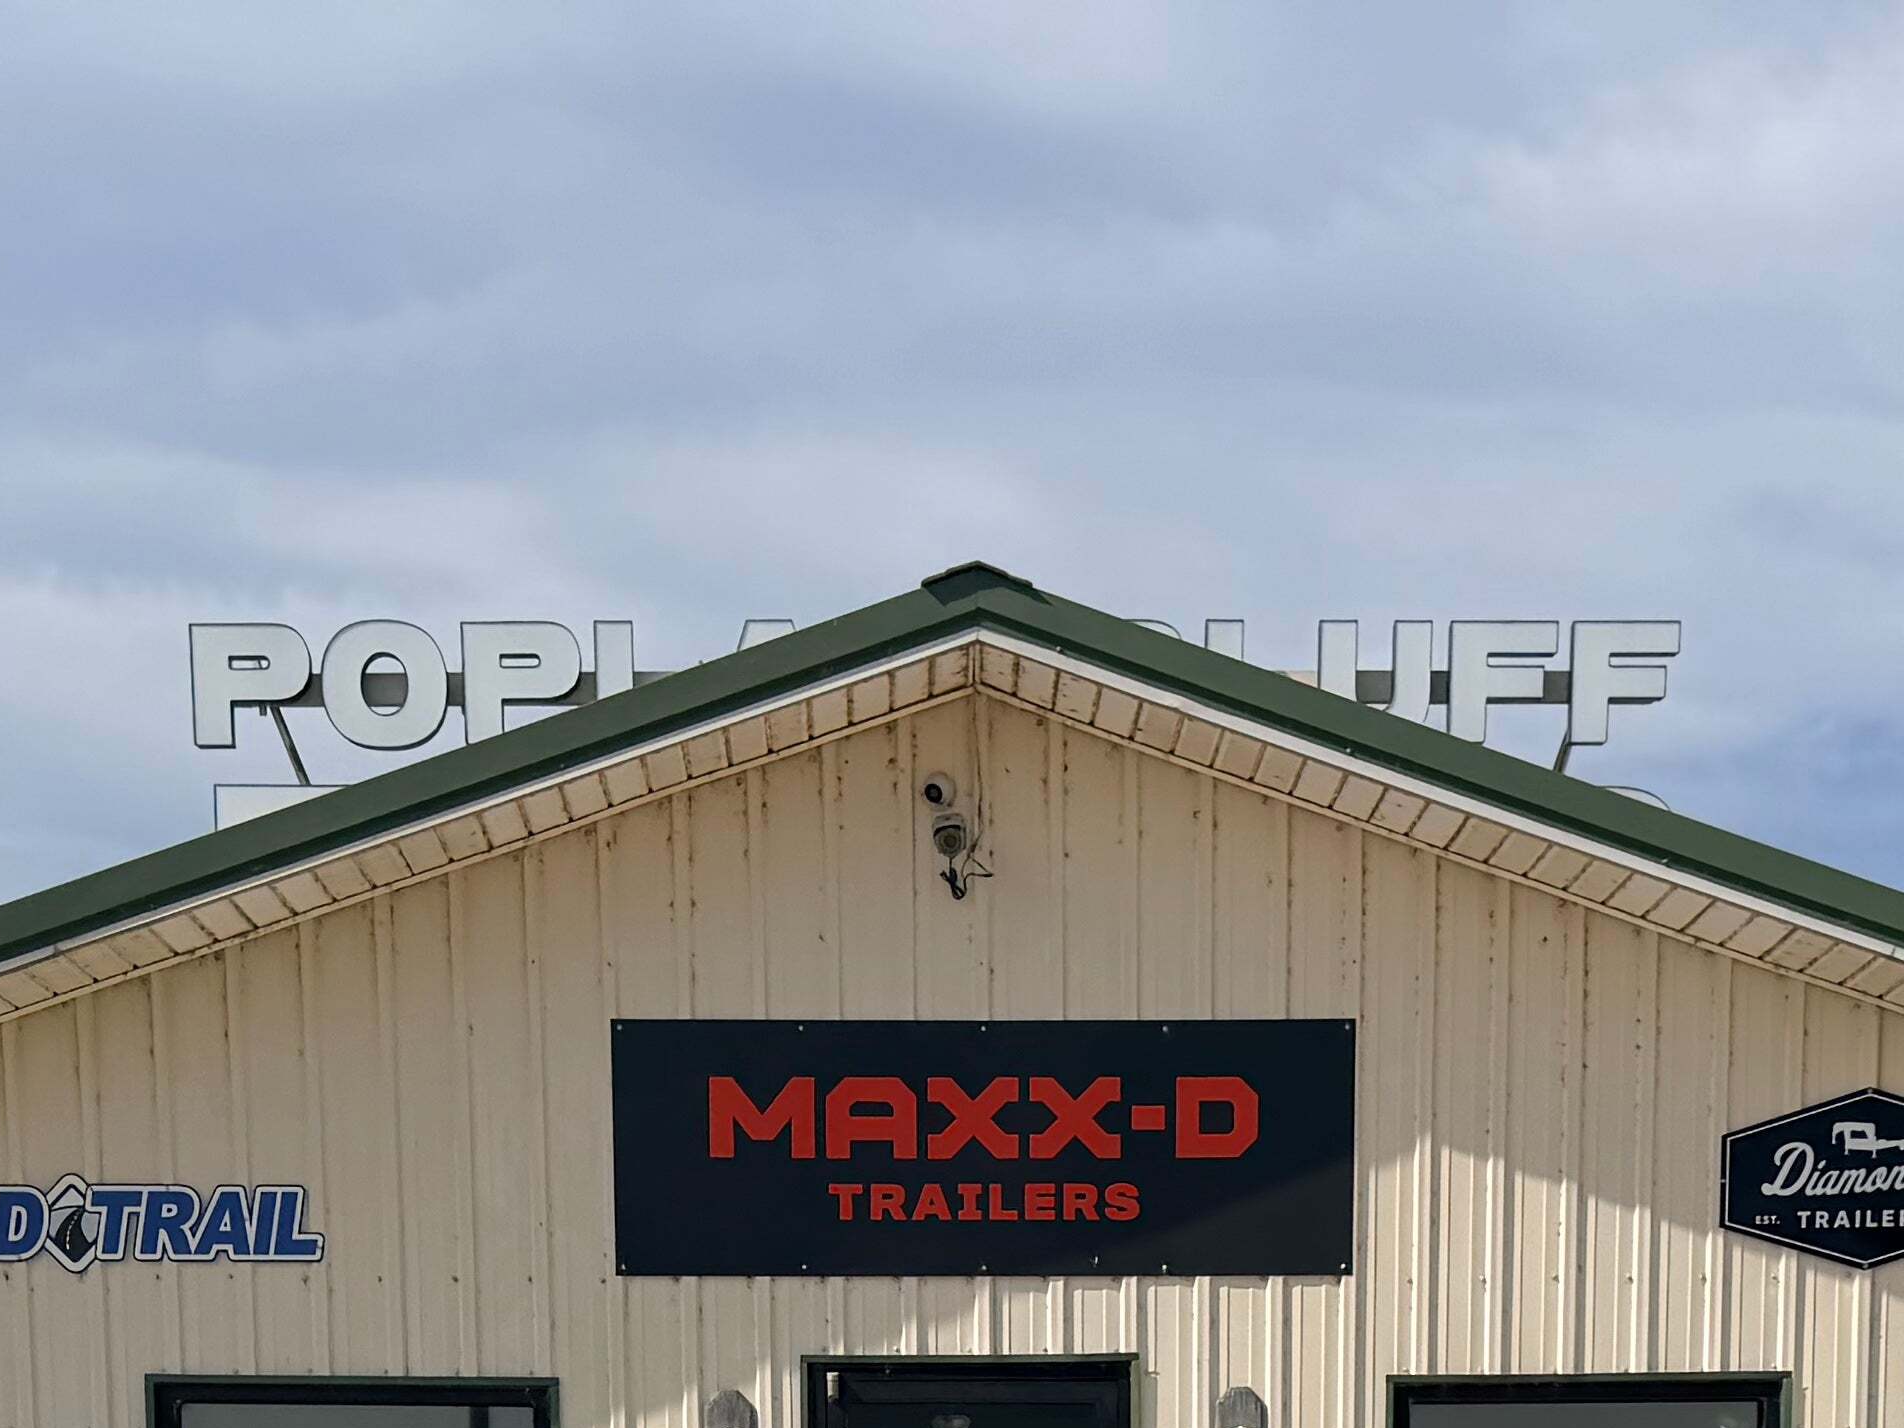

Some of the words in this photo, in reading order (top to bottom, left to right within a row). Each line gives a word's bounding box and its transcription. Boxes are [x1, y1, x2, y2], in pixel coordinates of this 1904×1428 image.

[707, 1075, 1261, 1160] MAXX-D
[86, 1187, 324, 1259] TRAIL
[828, 1181, 1142, 1221] TRAILERS
